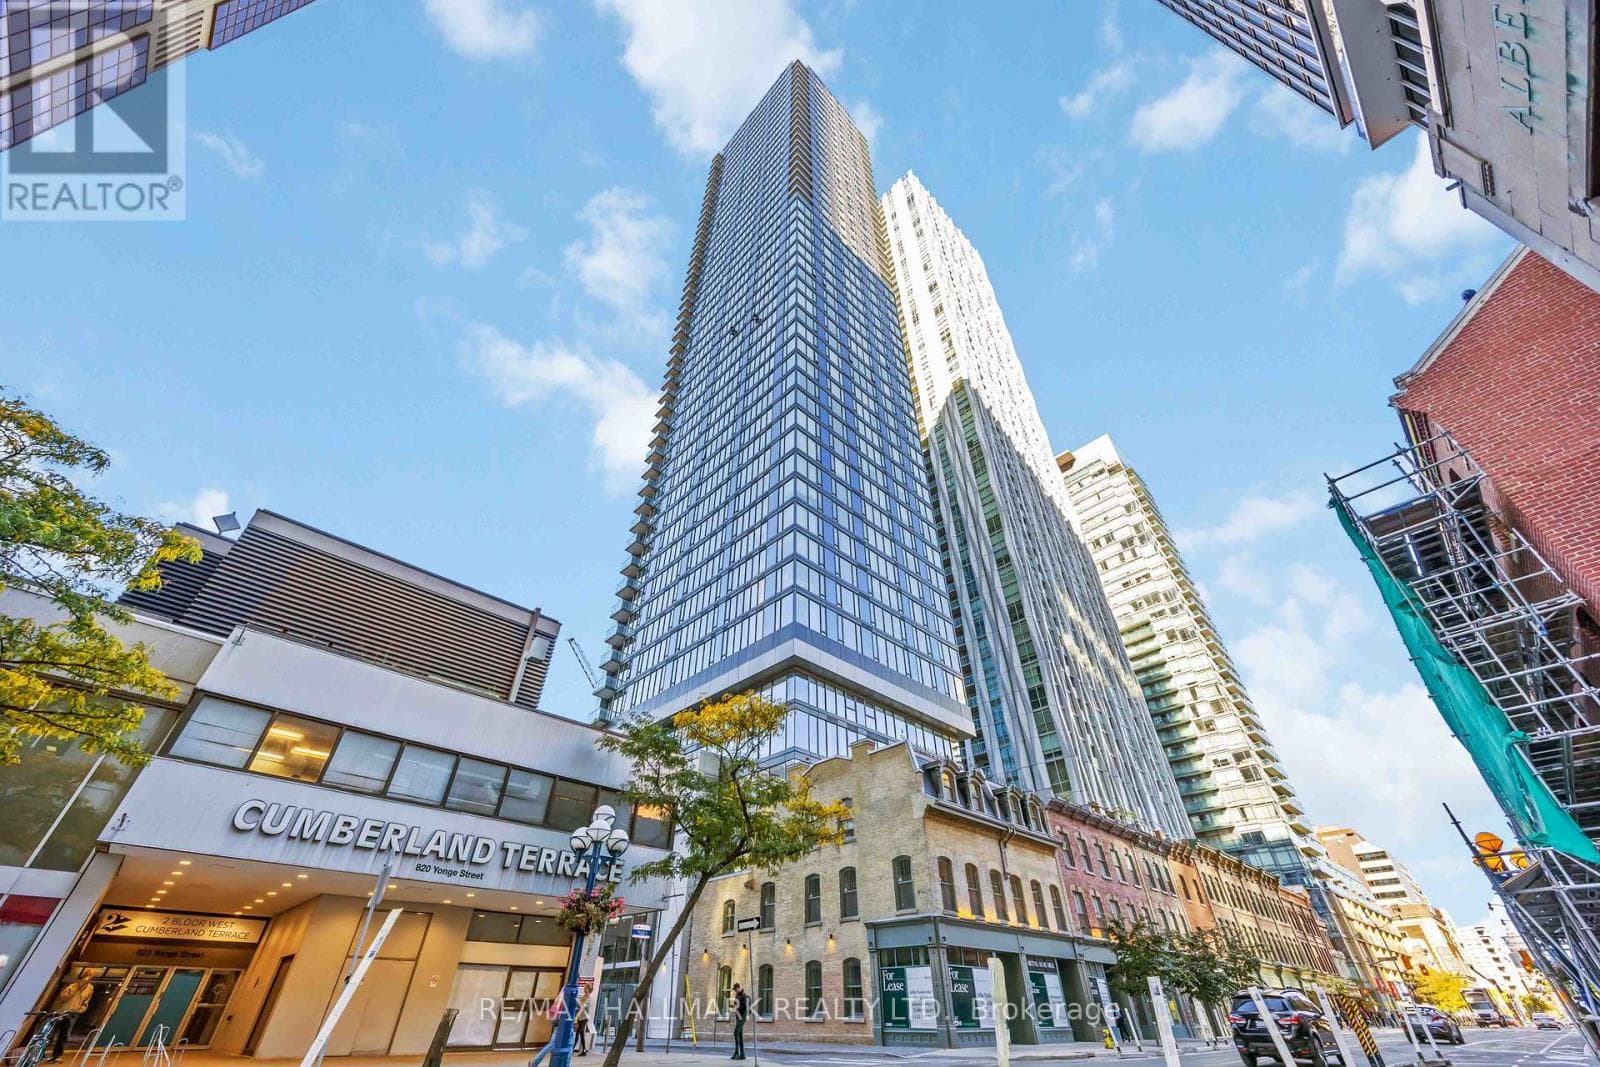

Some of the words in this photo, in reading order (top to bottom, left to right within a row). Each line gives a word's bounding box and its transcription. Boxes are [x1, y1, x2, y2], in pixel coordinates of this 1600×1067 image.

[233, 799, 497, 865] CUMBERLAND
[415, 863, 431, 873] 820
[433, 866, 459, 879] Yonge
[459, 869, 484, 880] Street
[162, 917, 169, 925] 2
[171, 917, 207, 927] BLOOR
[208, 920, 236, 929] WEST
[135, 925, 206, 937] CUMBERLAND
[208, 930, 251, 940] TERRACE
[882, 970, 895, 980] For
[883, 980, 904, 991] Lease
[950, 980, 969, 993] Lease
